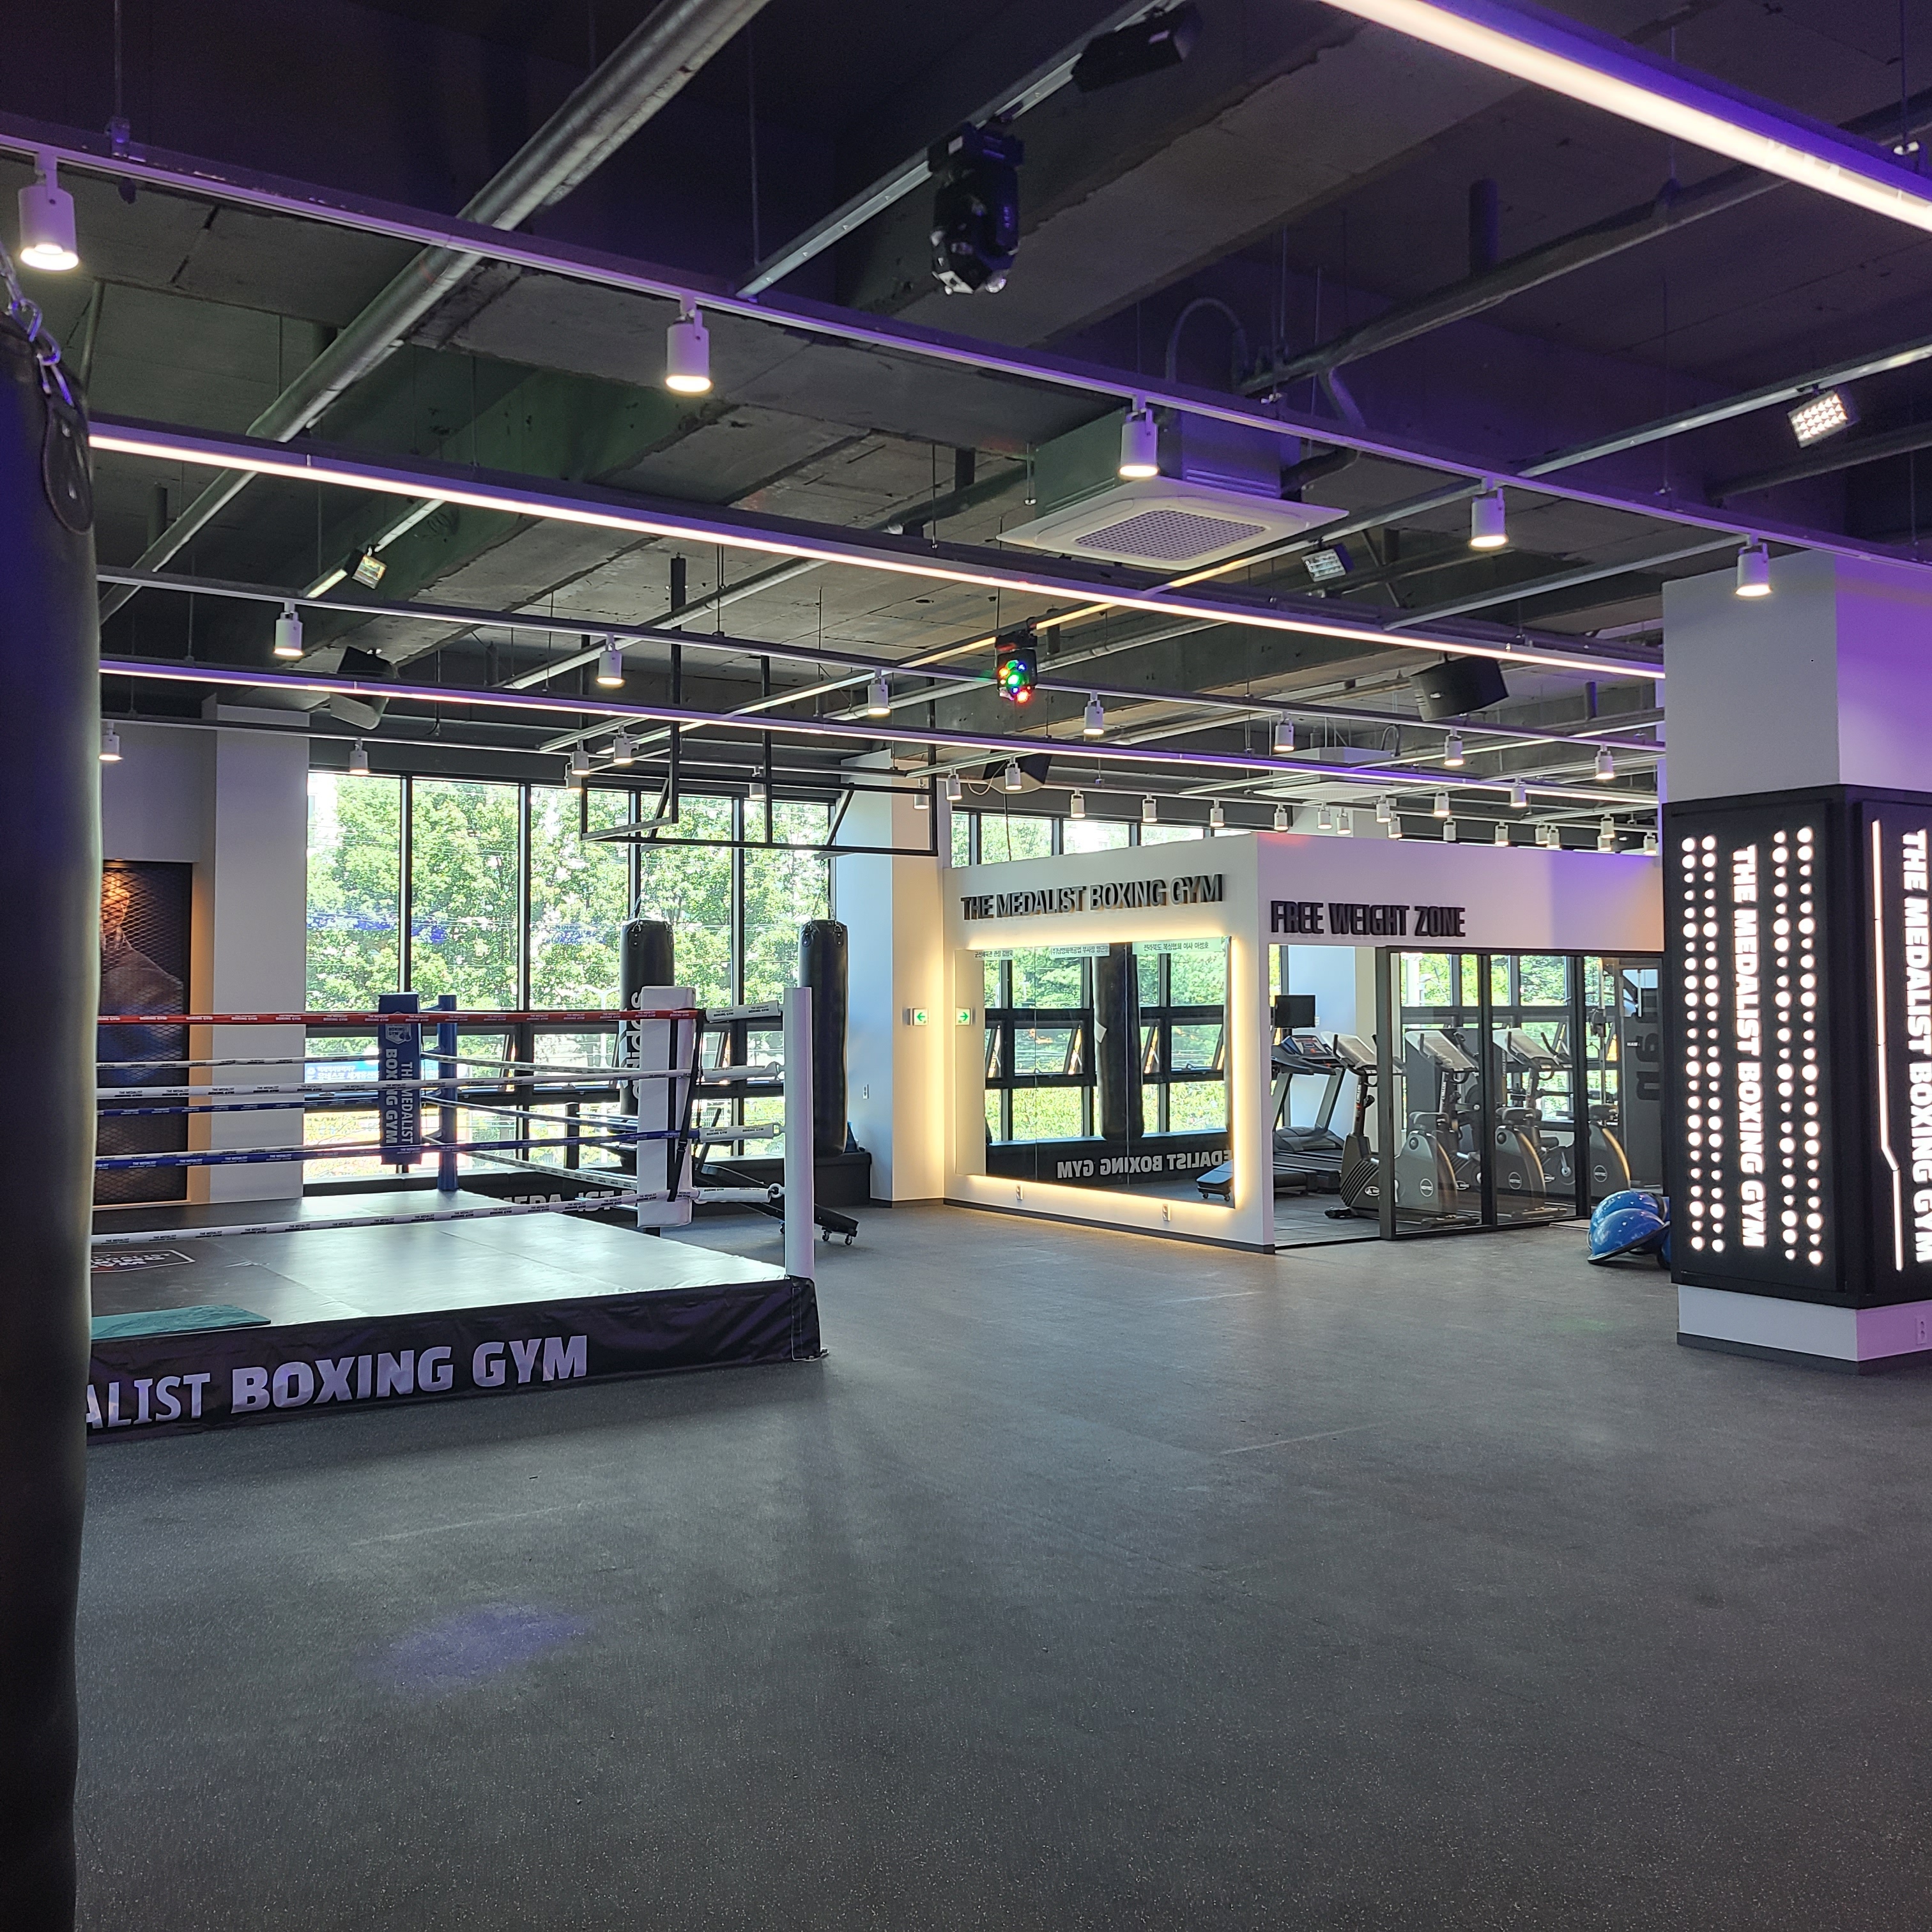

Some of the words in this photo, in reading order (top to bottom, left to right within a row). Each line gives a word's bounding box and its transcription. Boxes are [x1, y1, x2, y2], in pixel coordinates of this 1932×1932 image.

[1733, 844, 1757, 903] THE
[1902, 829, 1928, 891] THE
[961, 895, 994, 921] THE
[997, 885, 1086, 917] MEDALIST
[1090, 879, 1167, 910] BOXING
[1170, 874, 1223, 905] GYM
[1271, 901, 1324, 934] FREE
[1328, 903, 1409, 936] WEIGHT
[1414, 906, 1466, 937] ZONE
[1733, 908, 1760, 1056] MEDALIST
[1903, 895, 1932, 1056] MEDALIST
[385, 1048, 398, 1106] BOXNG
[385, 1109, 398, 1144] GYM
[1737, 1062, 1764, 1174] BOXING
[1909, 1062, 1932, 1183] BOXING
[1740, 1180, 1766, 1247] GYM
[1913, 1190, 1932, 1262] GYM
[231, 1346, 454, 1414] BOXING
[473, 1335, 587, 1387] GYM
